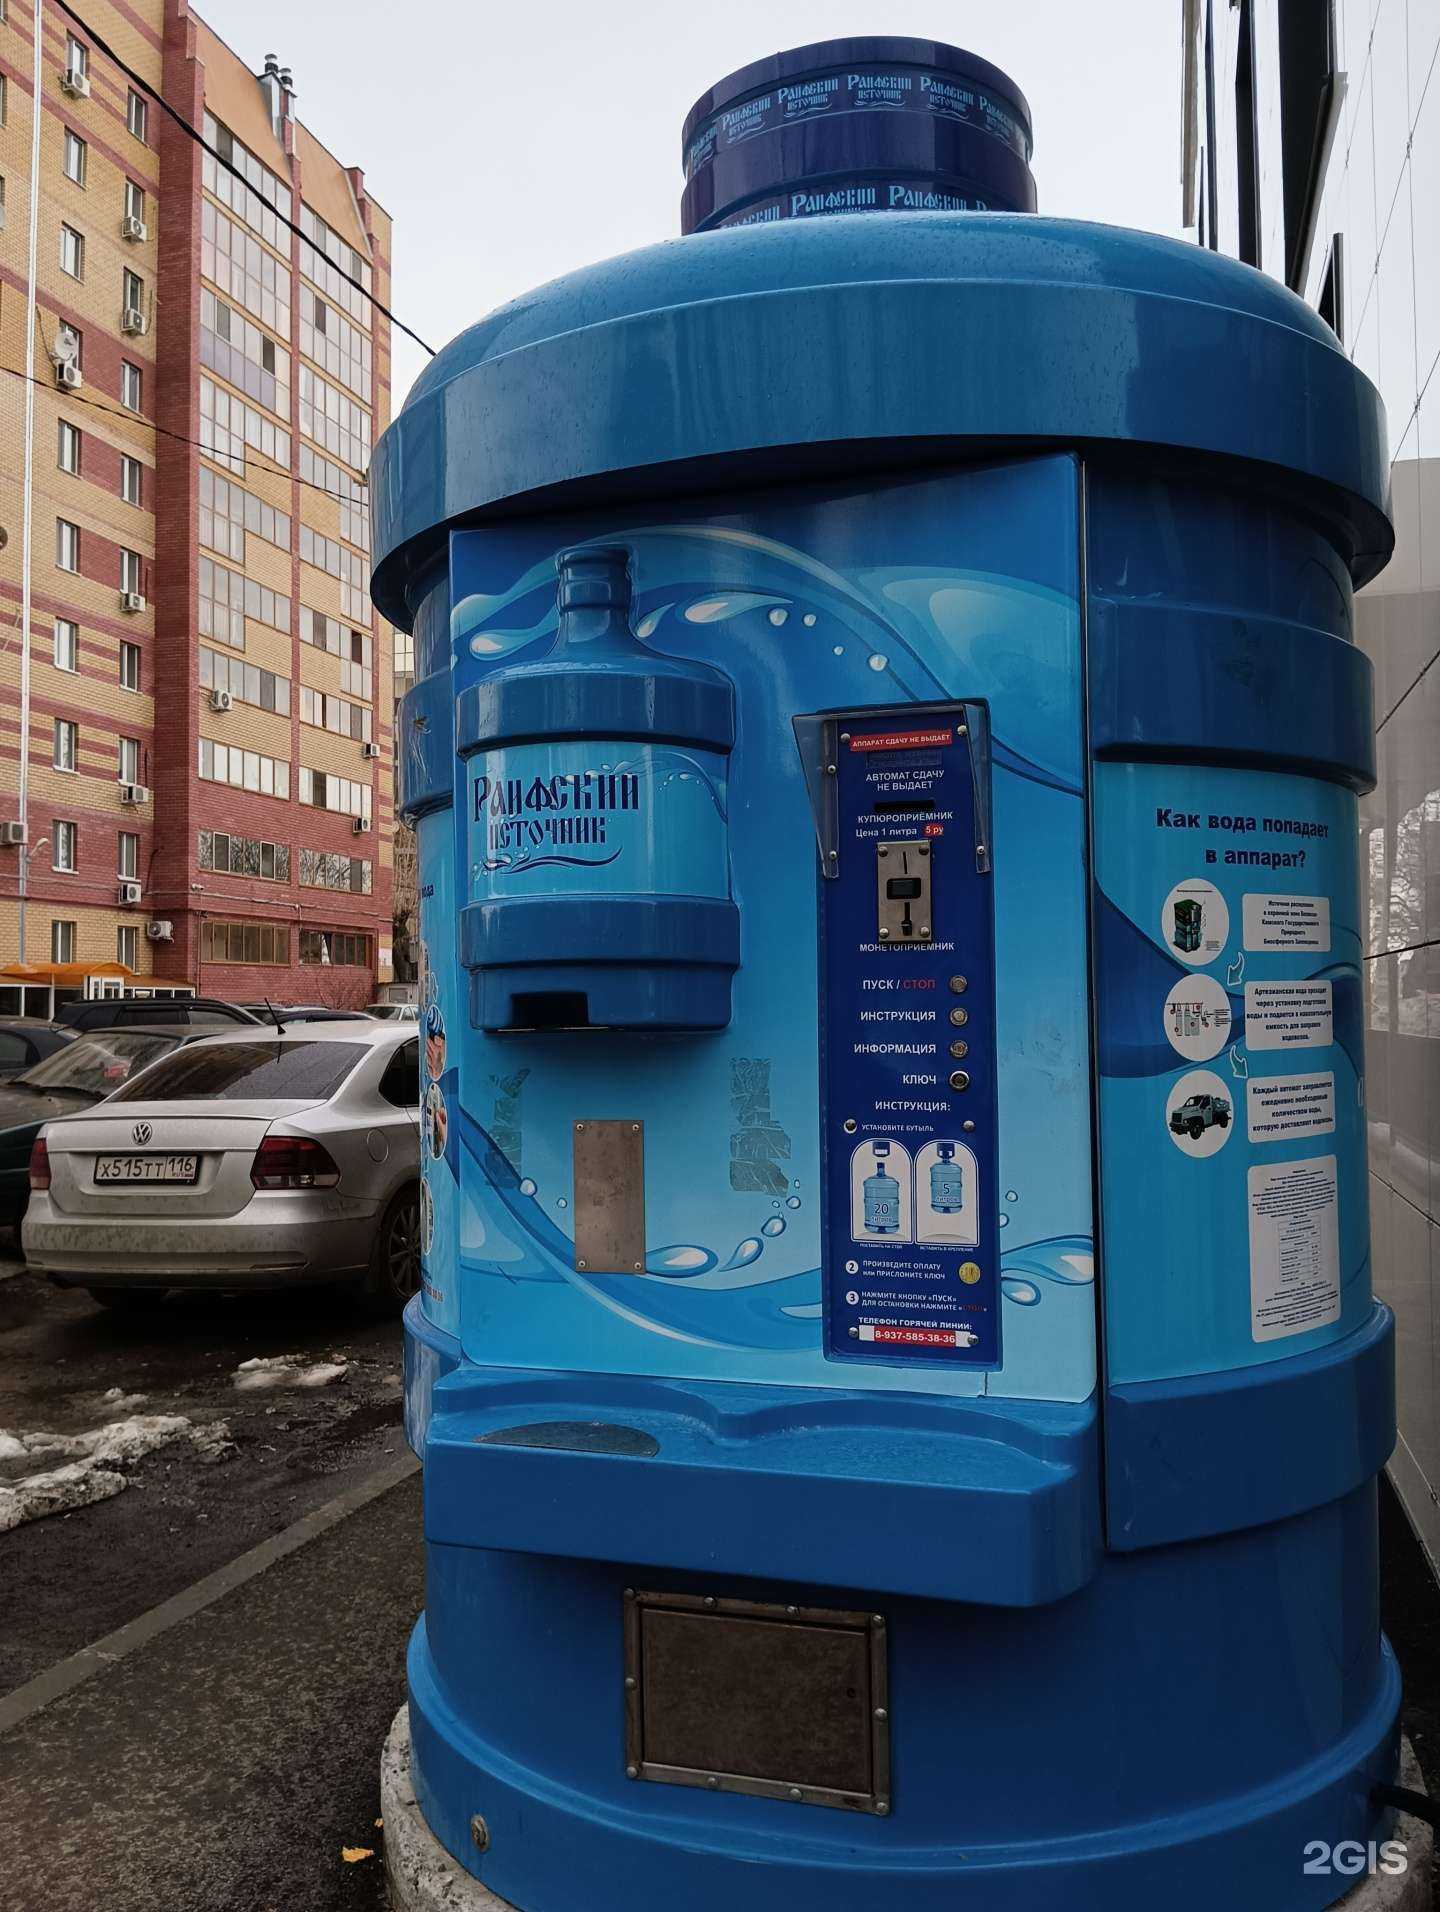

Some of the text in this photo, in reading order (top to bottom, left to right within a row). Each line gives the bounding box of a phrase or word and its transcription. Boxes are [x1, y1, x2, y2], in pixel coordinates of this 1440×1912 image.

[853, 739, 883, 748] АППАРАТ
[885, 738, 909, 746] СДАЧУ
[865, 769, 945, 782] АВТОМАТ СДАЧУ
[877, 780, 934, 792] НЕ ВЫДАЕТ
[1156, 808, 1329, 839] Как вода попадает
[855, 828, 879, 838] Цена
[881, 828, 886, 837] 1
[889, 828, 917, 837] литра
[924, 825, 932, 834] 5
[1205, 849, 1306, 870] в аппарат?
[862, 979, 894, 990] ПУСК
[903, 979, 936, 990] СТОП
[860, 1011, 936, 1022] ИНСТРУКЦИЯ
[854, 1044, 937, 1055] ИНФОРМАЦИЯ
[902, 1074, 937, 1085] КЛЮЧ
[875, 1100, 951, 1113] ИНСТРУКЦИЯ:
[861, 1123, 934, 1132] УСТАНОВИТЕ БУТЫЛЬ
[168, 1157, 193, 1173] 116
[943, 1183, 951, 1195] 5
[873, 1203, 889, 1215] 20
[862, 1260, 912, 1270] ПРОИЗВЕДИТЕ
[913, 1262, 941, 1271] ОПЛАТУ
[876, 1269, 923, 1280] ПРИСЛОНИТЕ
[924, 1272, 945, 1280] КЛЮЧ
[861, 1290, 897, 1300] НАЖМИТЕ
[898, 1293, 926, 1301] КНОПКУ
[861, 1300, 877, 1309] ДЛЯ
[877, 1300, 920, 1309] ОСТАНОВКИ
[920, 1303, 957, 1312] НАЖМИТЕ
[858, 1316, 973, 1331] ТЕЛЕФОН ГОРЯЧЕЙ ЛИНИИ:
[874, 1330, 956, 1344] 8-937-585-38-36
